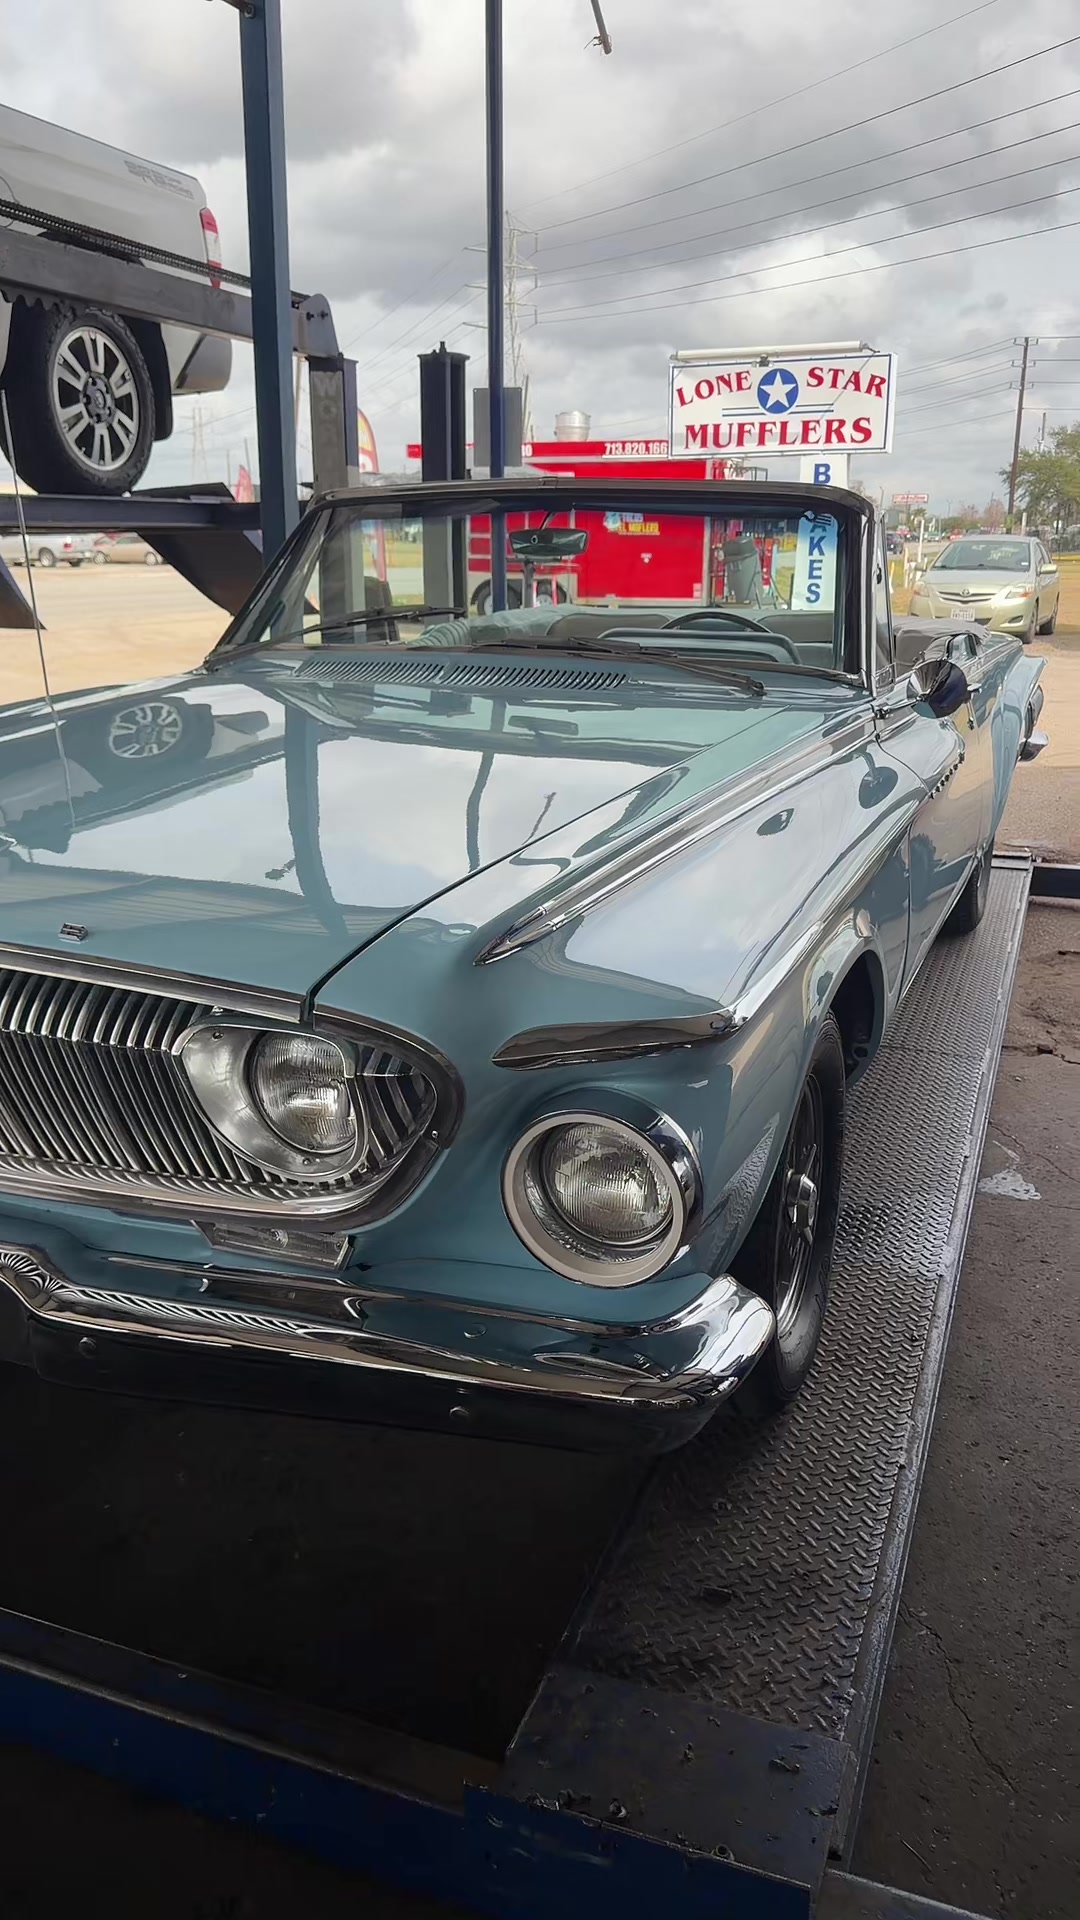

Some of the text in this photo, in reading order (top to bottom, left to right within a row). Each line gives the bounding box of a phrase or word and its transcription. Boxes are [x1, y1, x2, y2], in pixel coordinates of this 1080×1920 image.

[675, 366, 887, 408] LONE STAR
[684, 417, 873, 450] MUFFLERS
